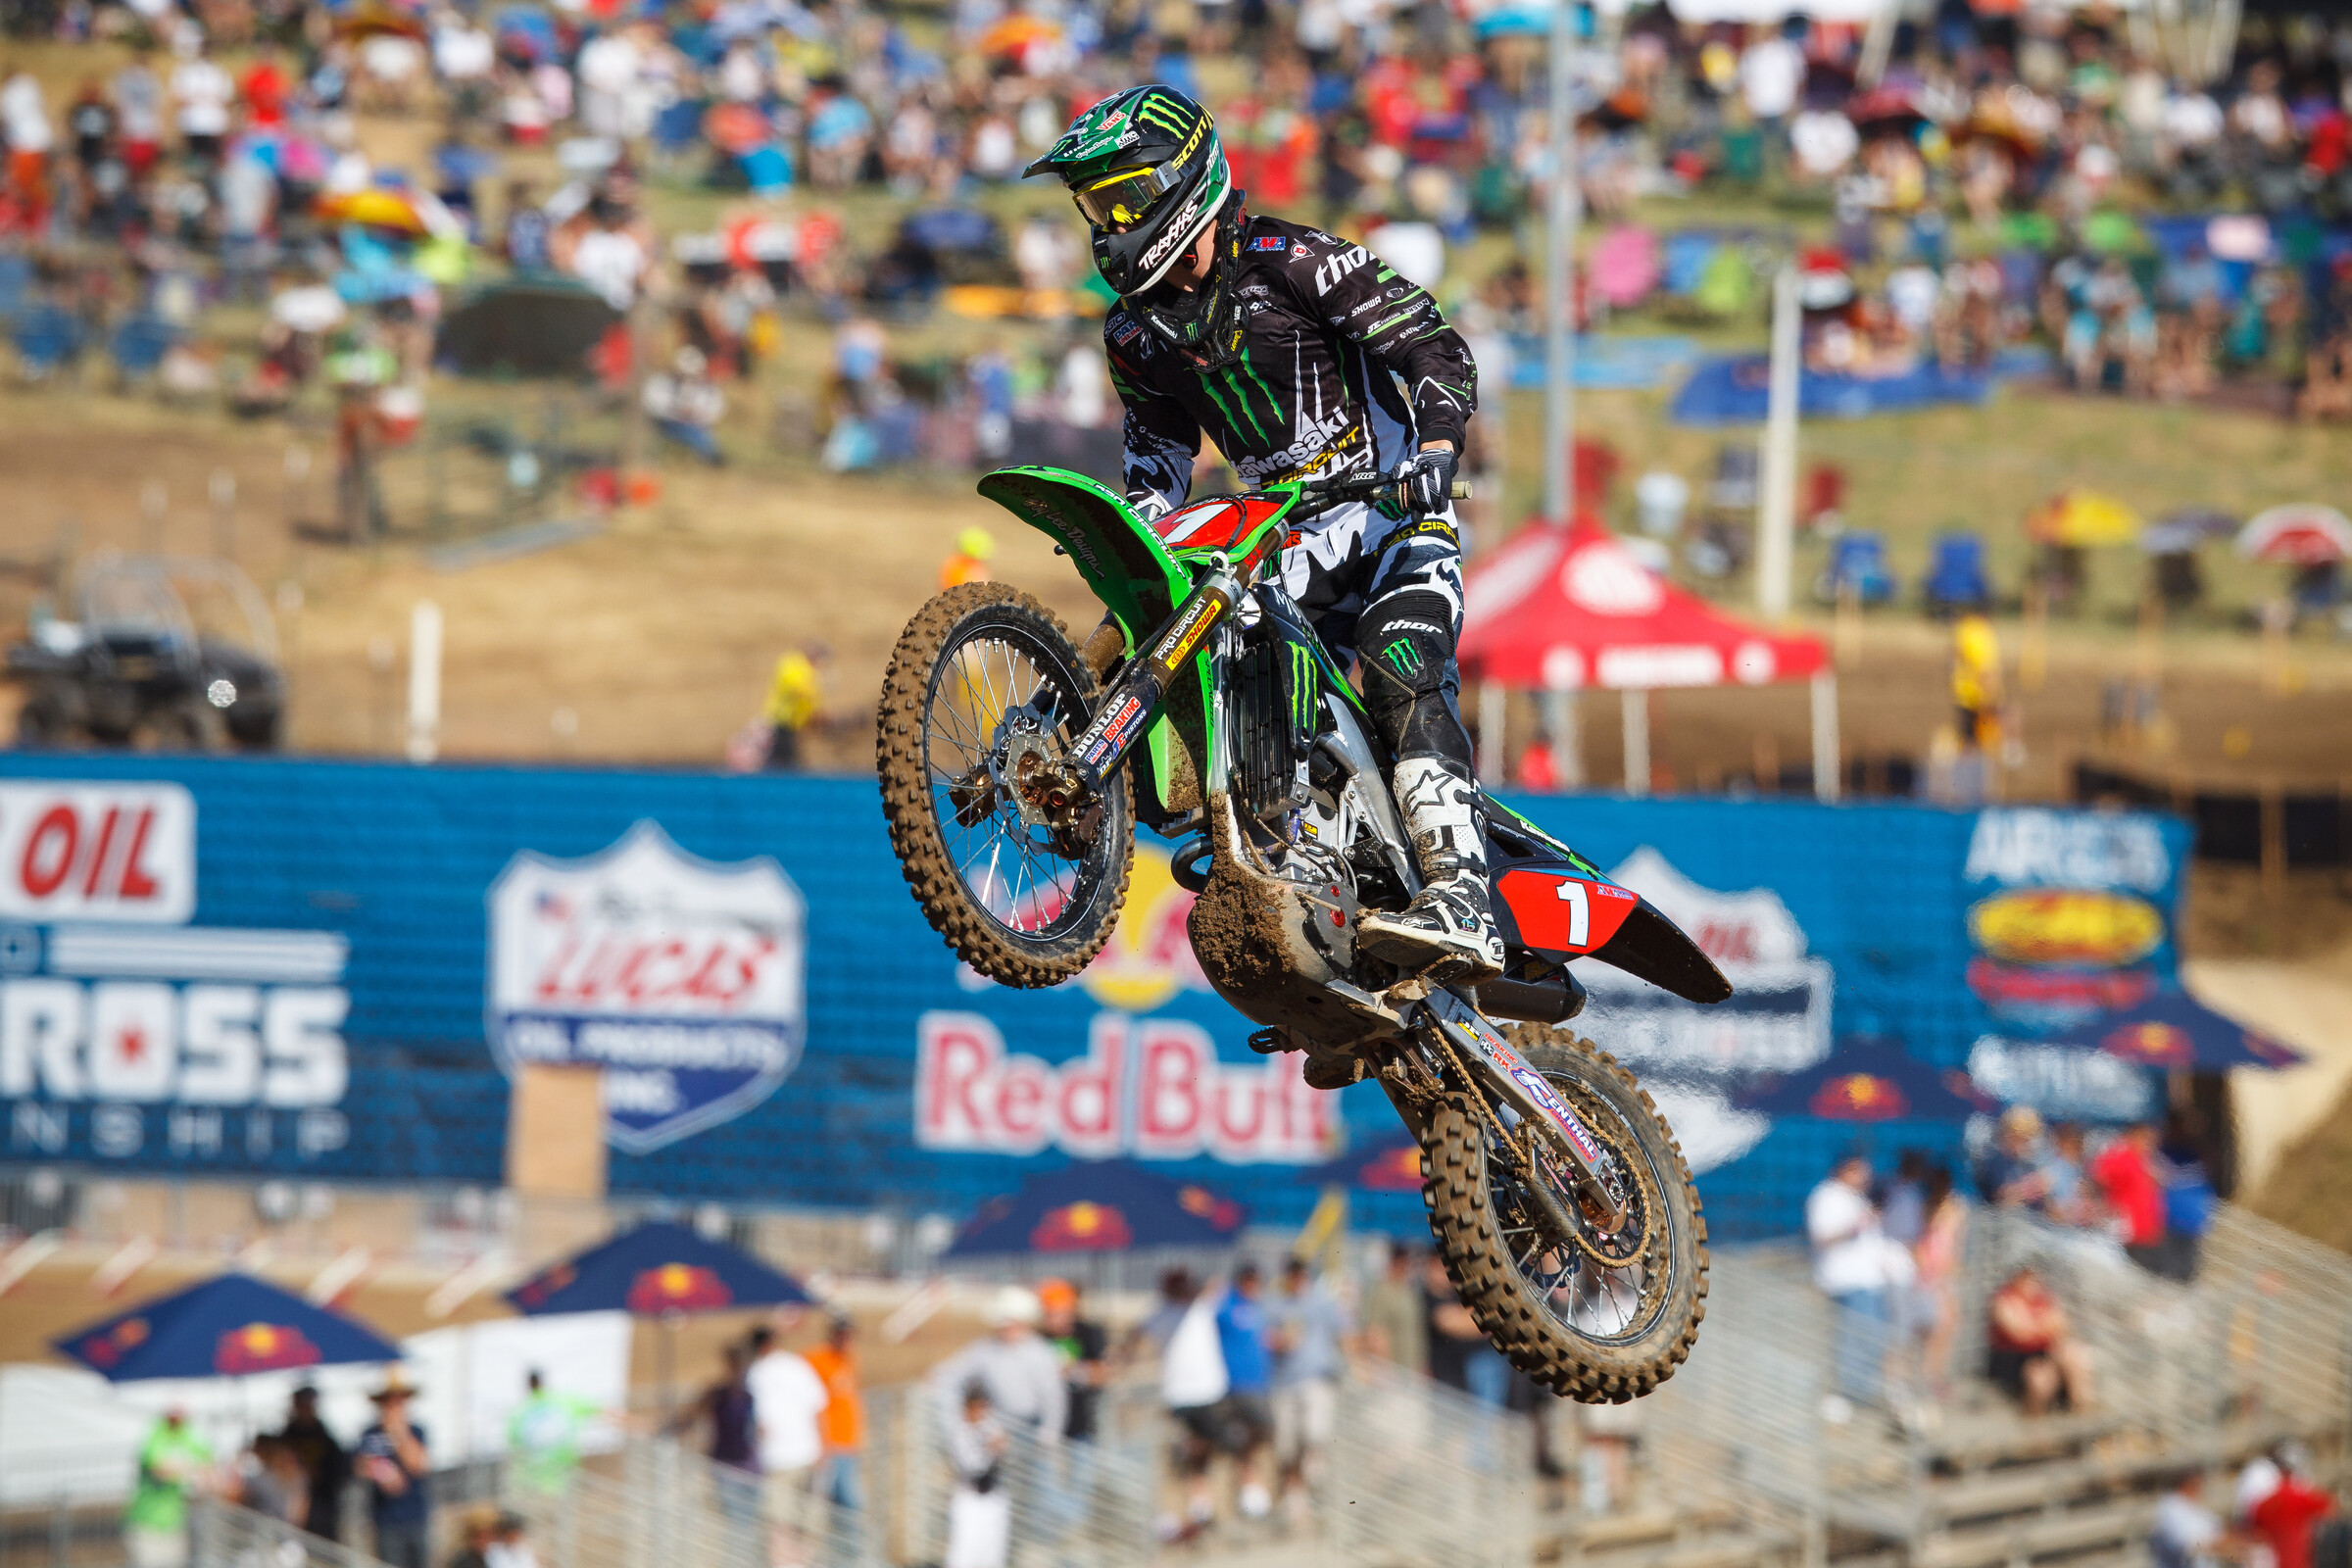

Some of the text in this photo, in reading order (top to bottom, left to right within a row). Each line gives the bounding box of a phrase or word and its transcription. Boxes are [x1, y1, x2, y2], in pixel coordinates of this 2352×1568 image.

[1098, 111, 1126, 130] VANS
[1172, 116, 1207, 171] SCOTT
[1139, 199, 1199, 270] TRAXXAS
[1247, 236, 1286, 251] AMA
[1351, 296, 1382, 317] SHOWA
[1113, 320, 1137, 340] PAR
[1278, 425, 1359, 484] CIRCUIT
[1127, 506, 1186, 579] CIRCUIT
[1164, 503, 1234, 544] 1
[1281, 530, 1301, 549] NS
[1418, 521, 1460, 549] CIRC
[1066, 526, 1105, 580] Designs
[1244, 544, 1262, 571] SFF
[1154, 596, 1206, 661] PRO CIRCUIT
[1186, 605, 1216, 647] SHOWA
[1382, 619, 1443, 634] thor
[1072, 693, 1126, 759] DUNLOP
[1103, 697, 1141, 743] BRAKING
[1124, 710, 1148, 738] PISTONS
[1087, 739, 1105, 761] PARTS
[18, 804, 160, 900] OIL
[1555, 880, 1590, 948] 1
[1484, 1032, 1518, 1064] BRAKING
[1493, 1052, 1510, 1071] RK
[924, 1024, 1334, 1147] Red Bull
